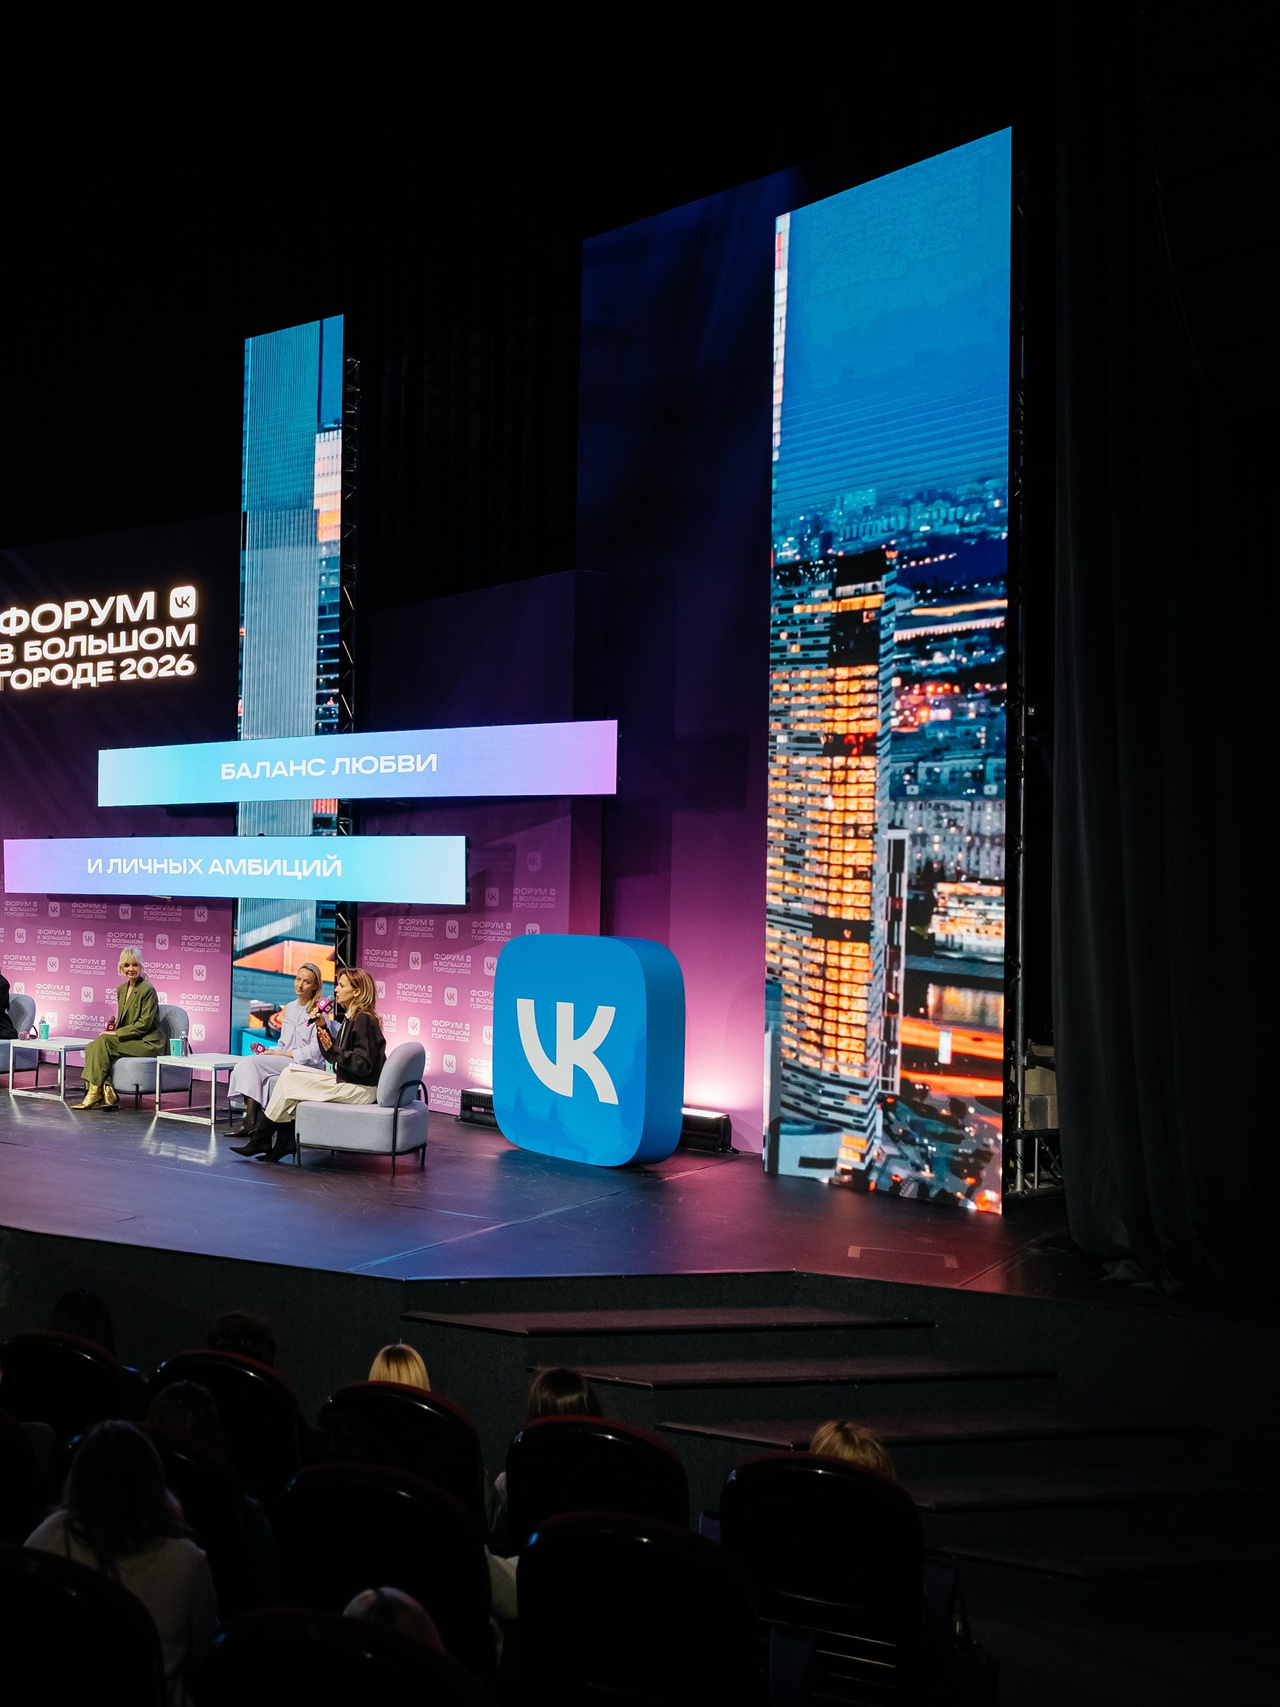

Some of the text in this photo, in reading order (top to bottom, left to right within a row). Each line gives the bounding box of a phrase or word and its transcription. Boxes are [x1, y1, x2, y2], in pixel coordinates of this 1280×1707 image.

[175, 596, 190, 608] VK
[24, 624, 196, 661] БОЛЬШОМ
[120, 654, 195, 680] 2026
[221, 753, 437, 780] БАЛАНС ЛЮБВИ
[88, 855, 342, 880] И ЛИЧНЫХ АМБИЦИЙ
[472, 921, 503, 929] ФОРУМ
[433, 954, 463, 962] ФОРУМ
[397, 983, 425, 991] ФОРУМ
[470, 990, 493, 999] ФОРУ
[432, 1020, 462, 1029] ФОРУМ
[517, 998, 618, 1105] VK
[431, 1085, 461, 1095] ФОРУМ
